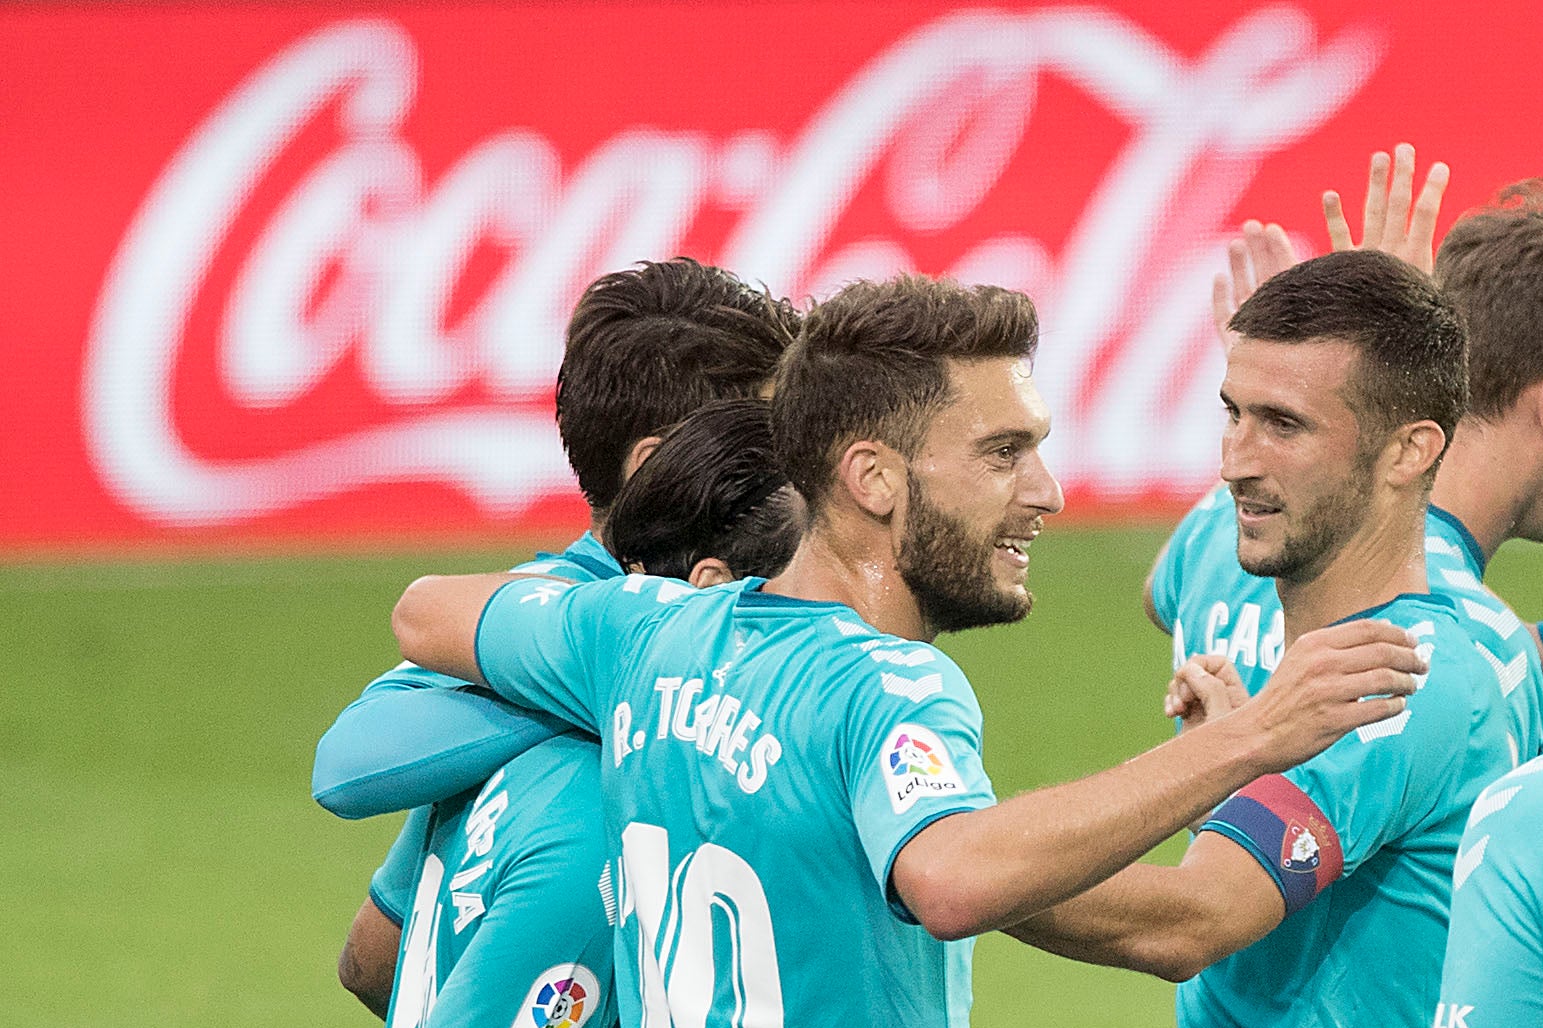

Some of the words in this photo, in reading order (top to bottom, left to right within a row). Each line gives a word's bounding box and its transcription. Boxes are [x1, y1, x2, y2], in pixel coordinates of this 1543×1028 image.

[82, 5, 1385, 525] Coca-Cla
[613, 702, 646, 768] R.
[897, 777, 957, 801] LaLiga
